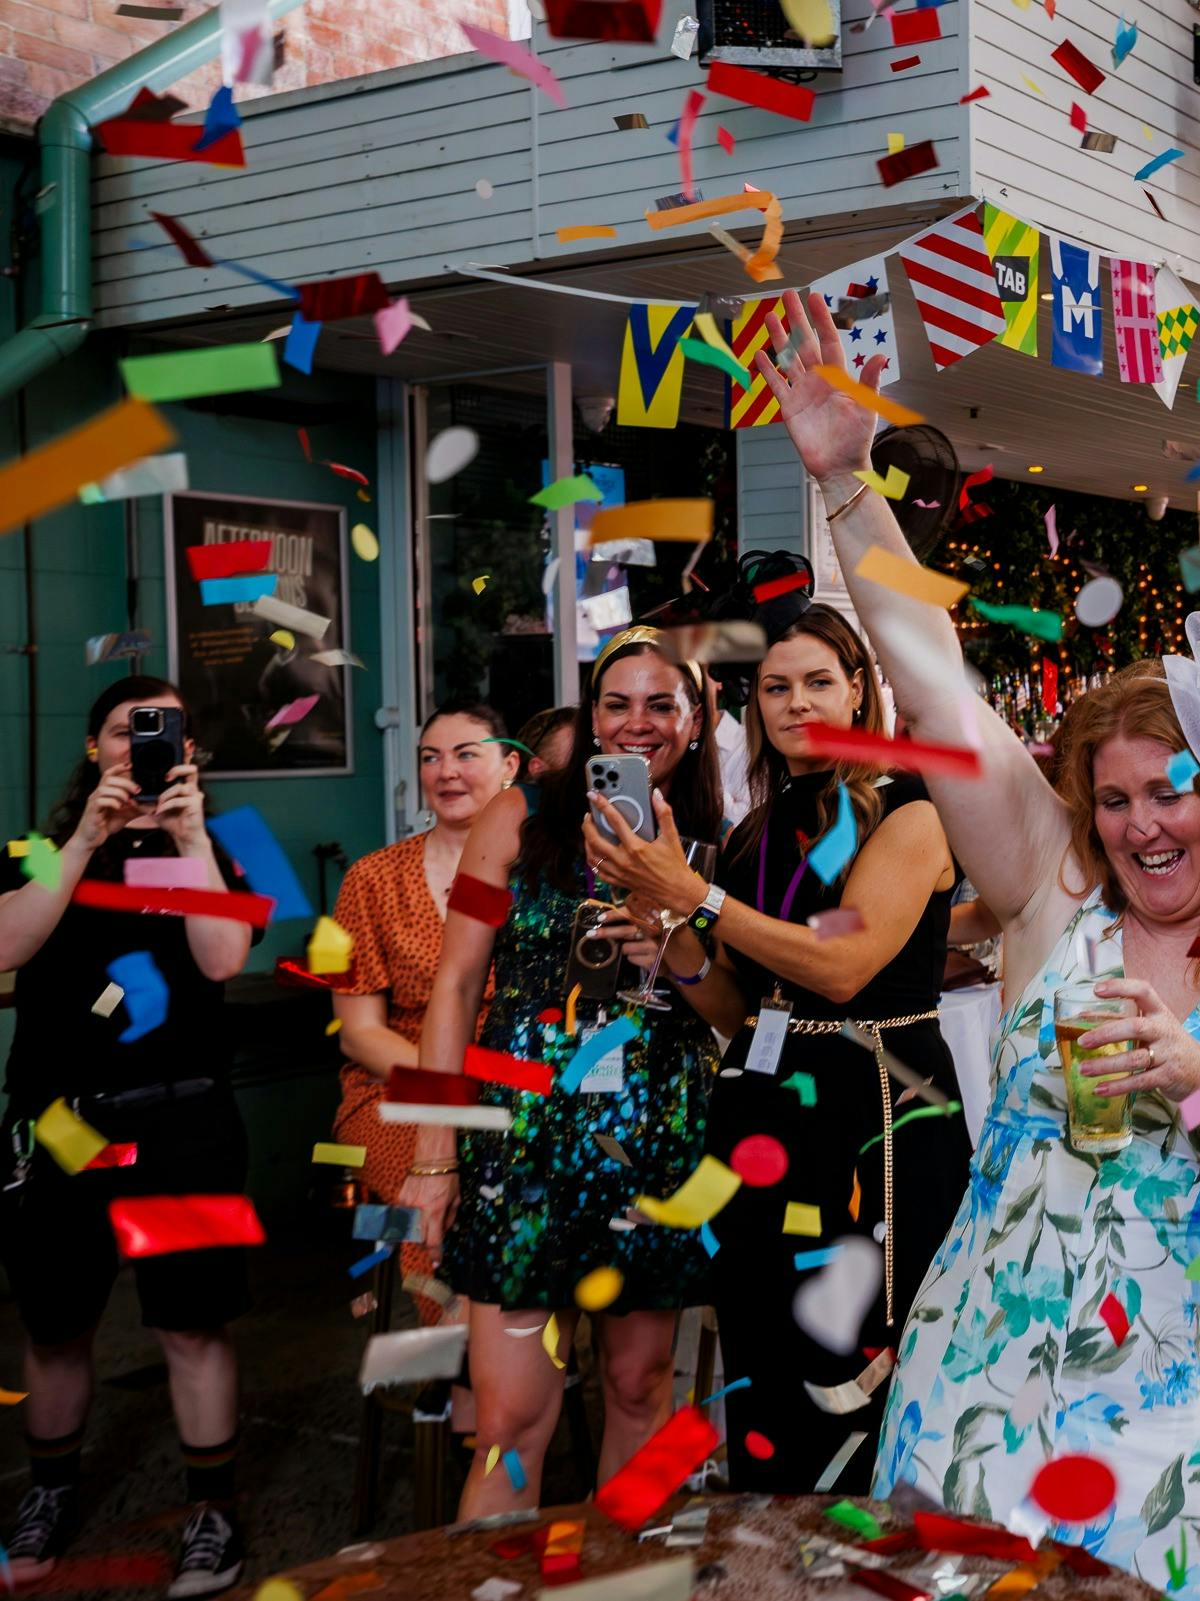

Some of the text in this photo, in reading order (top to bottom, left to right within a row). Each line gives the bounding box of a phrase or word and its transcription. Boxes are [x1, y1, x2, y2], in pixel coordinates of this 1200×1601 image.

[995, 261, 1026, 296] TAB
[1062, 284, 1094, 338] M
[205, 522, 313, 577] AFNOON
